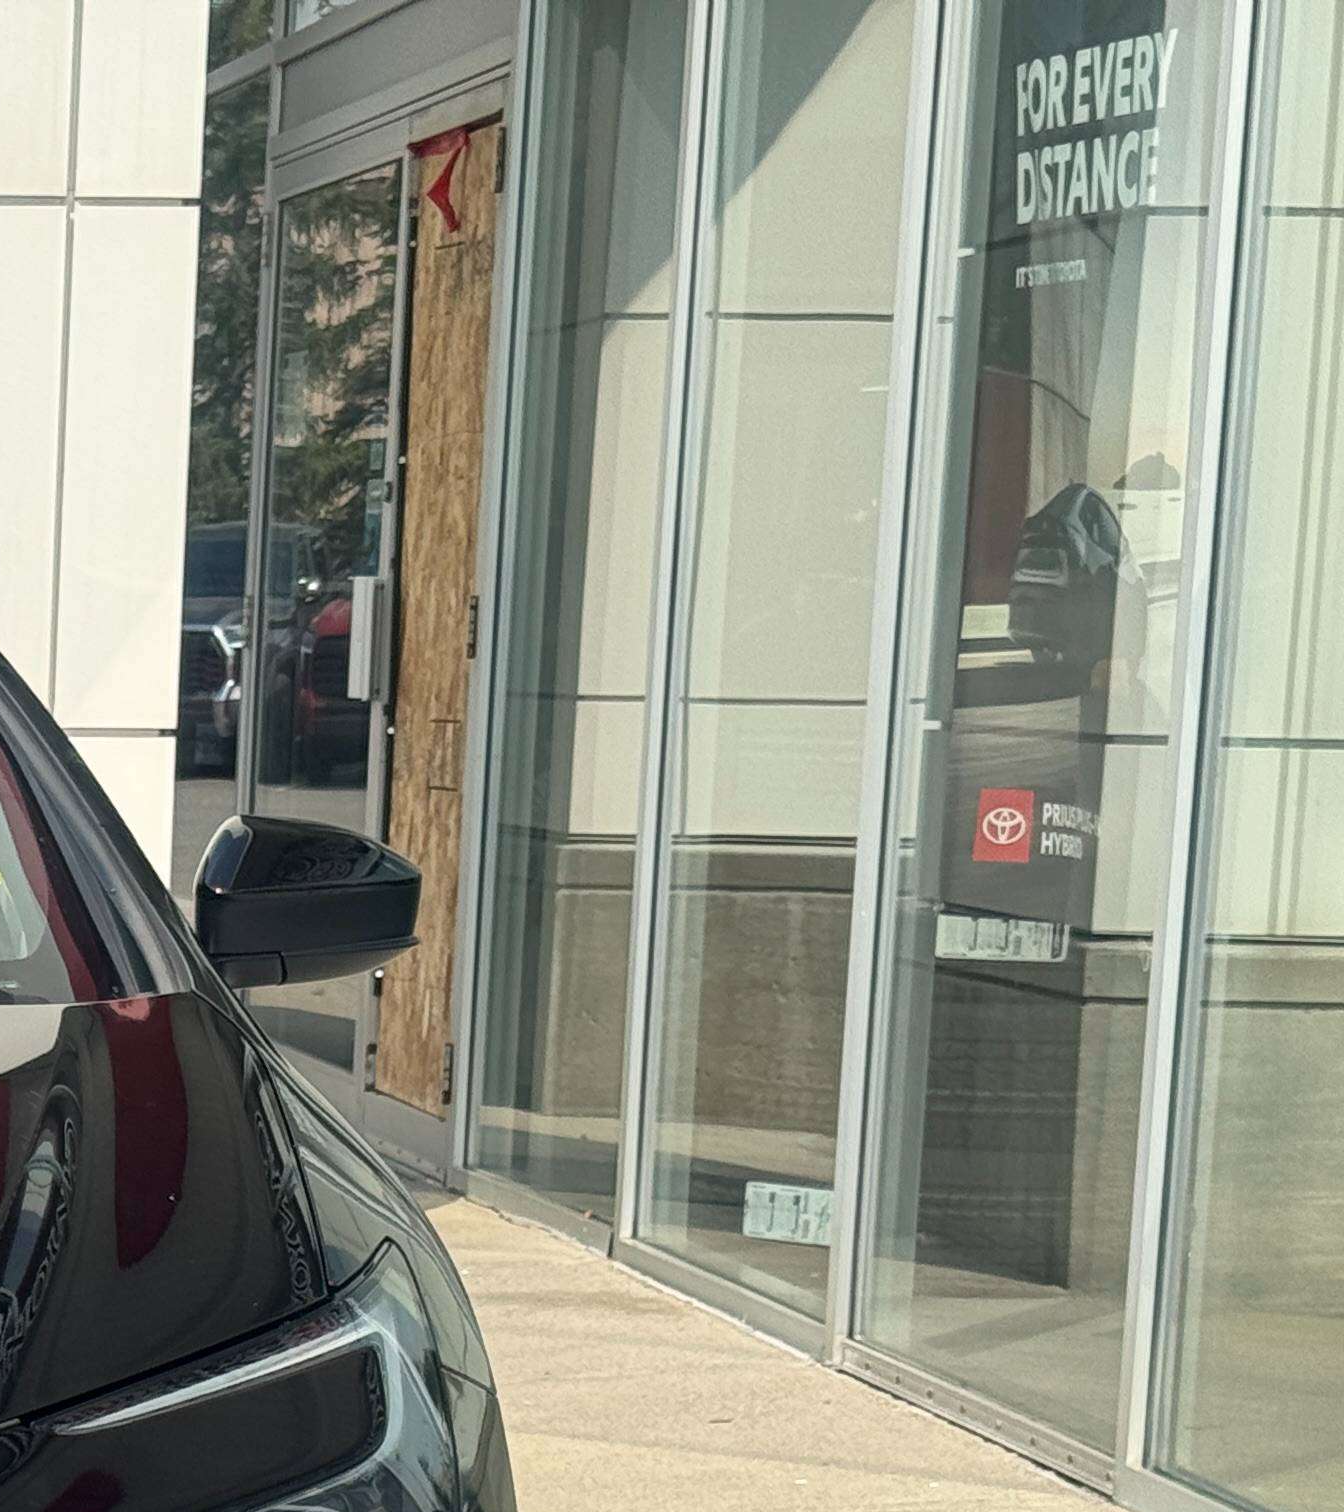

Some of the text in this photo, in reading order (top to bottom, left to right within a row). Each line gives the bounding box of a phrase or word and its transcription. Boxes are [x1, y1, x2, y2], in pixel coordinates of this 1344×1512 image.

[1015, 28, 1179, 137] FOR EVERY
[1015, 127, 1160, 225] DISTANCE
